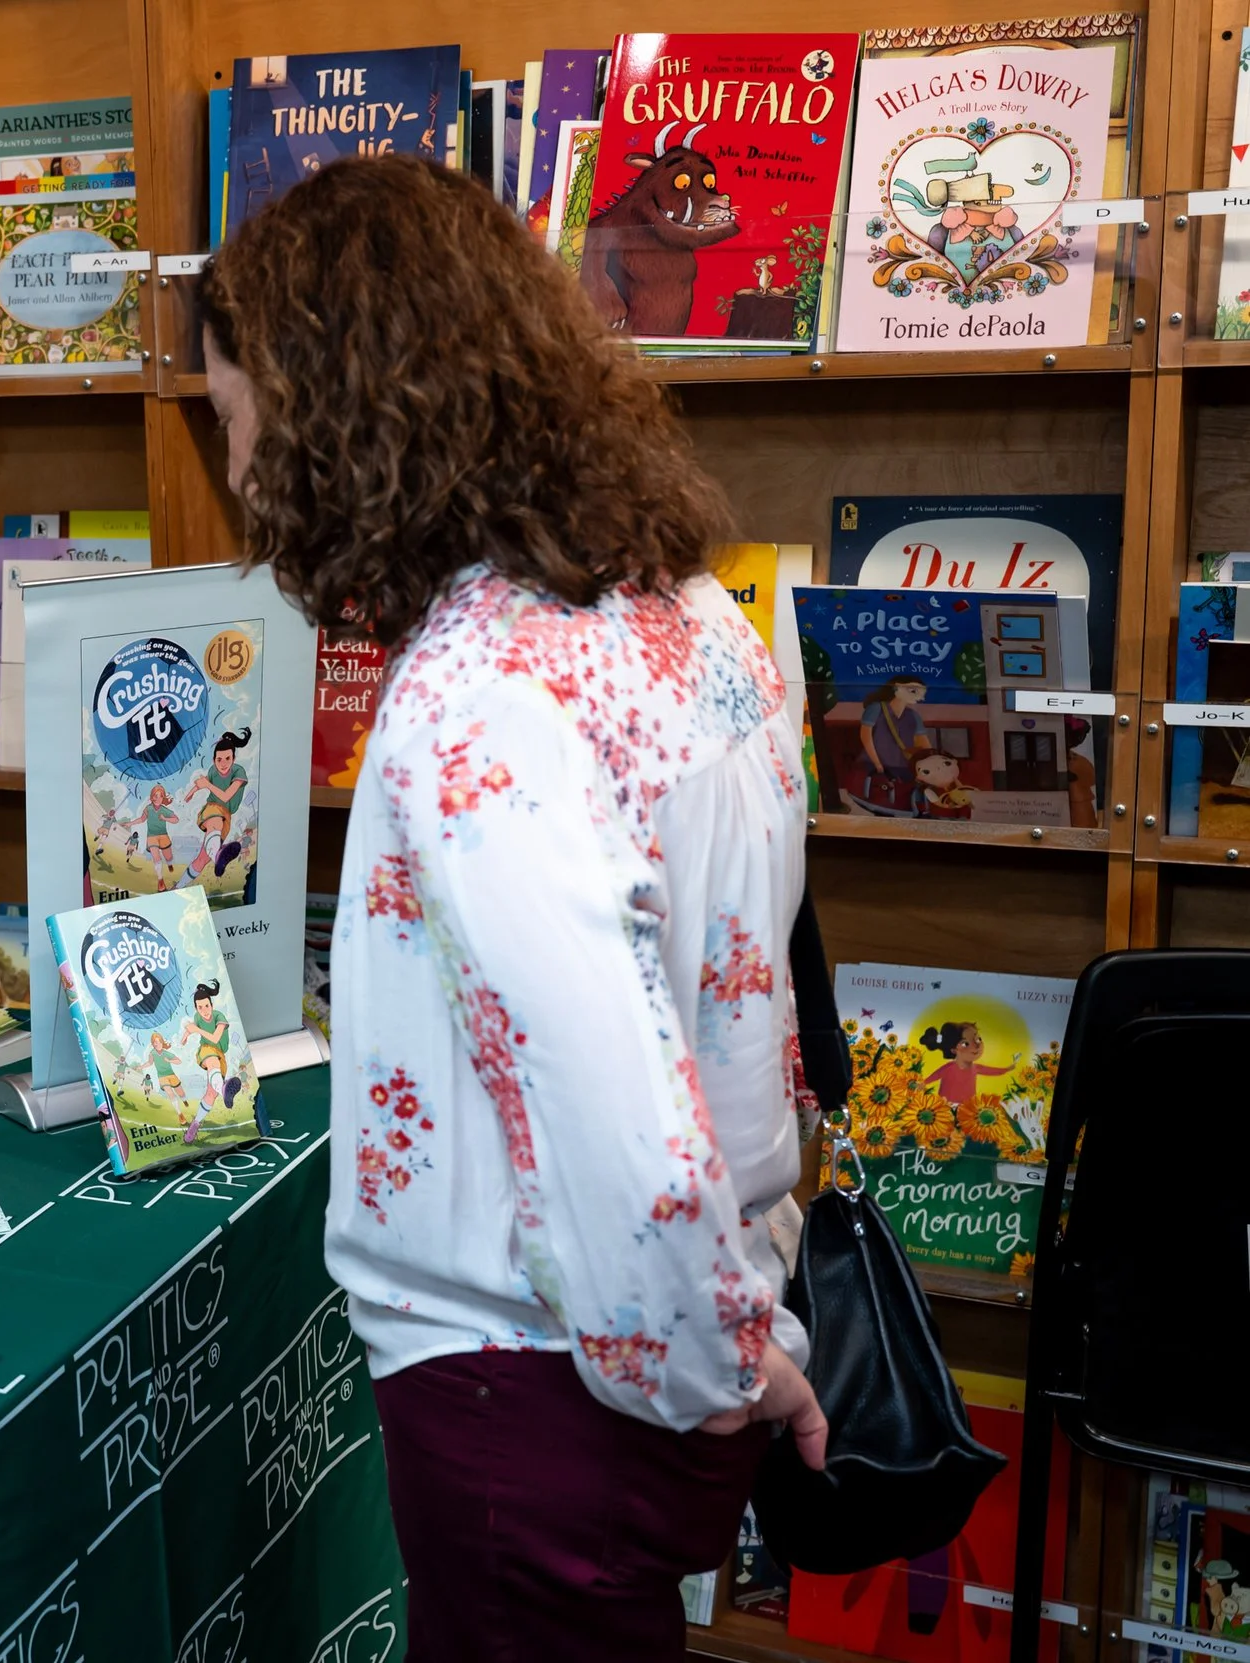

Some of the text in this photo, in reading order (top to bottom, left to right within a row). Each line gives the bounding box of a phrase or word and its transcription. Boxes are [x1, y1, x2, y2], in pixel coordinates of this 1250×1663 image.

[654, 55, 691, 78] THE
[316, 68, 367, 99] THE
[875, 63, 1090, 121] HELGA'S DOWRY
[623, 79, 835, 125] GRUFFALO
[937, 100, 1028, 116] A Troll Love Story
[105, 108, 133, 124] STO
[33, 136, 63, 146] WORDS
[70, 133, 102, 143] SPOKEN
[104, 131, 135, 141] MEMOR
[715, 145, 803, 163] Julia Donaldson
[733, 165, 757, 178] Axel
[22, 177, 131, 193] GETTING READY FOR
[1095, 207, 1112, 218] D
[11, 251, 55, 270] EACH
[180, 260, 192, 269] D
[14, 271, 109, 289] PEAR PLUM
[7, 292, 114, 306] Janet and Allan Ahlberg
[880, 312, 1047, 340] Tomie dePaola
[900, 541, 1056, 590] Du Iz
[832, 608, 950, 633] A Place
[113, 641, 180, 665] Crushing on you
[121, 655, 139, 667] was
[139, 651, 165, 661] never
[164, 651, 178, 662] the
[870, 635, 953, 663] Stay
[319, 657, 384, 684] Yellow
[856, 661, 944, 679] A Shelter Story
[97, 662, 206, 729] Crushing
[317, 686, 372, 713] Leaf
[130, 700, 172, 754] It
[98, 886, 131, 905] Erin
[224, 919, 272, 942] Weekly
[84, 931, 171, 990] Crushing
[118, 962, 153, 1009] It
[850, 975, 926, 993] LOUISE GREIG
[129, 1122, 159, 1140] Erin
[133, 1131, 179, 1153] Becker
[894, 1147, 944, 1180] The
[874, 1173, 1036, 1214] Enormous
[902, 1205, 1030, 1256] Morning
[905, 1242, 997, 1267] Every day has a story
[76, 1243, 226, 1438] POLITICS
[146, 1363, 173, 1407] AND
[293, 1399, 315, 1438] AND
